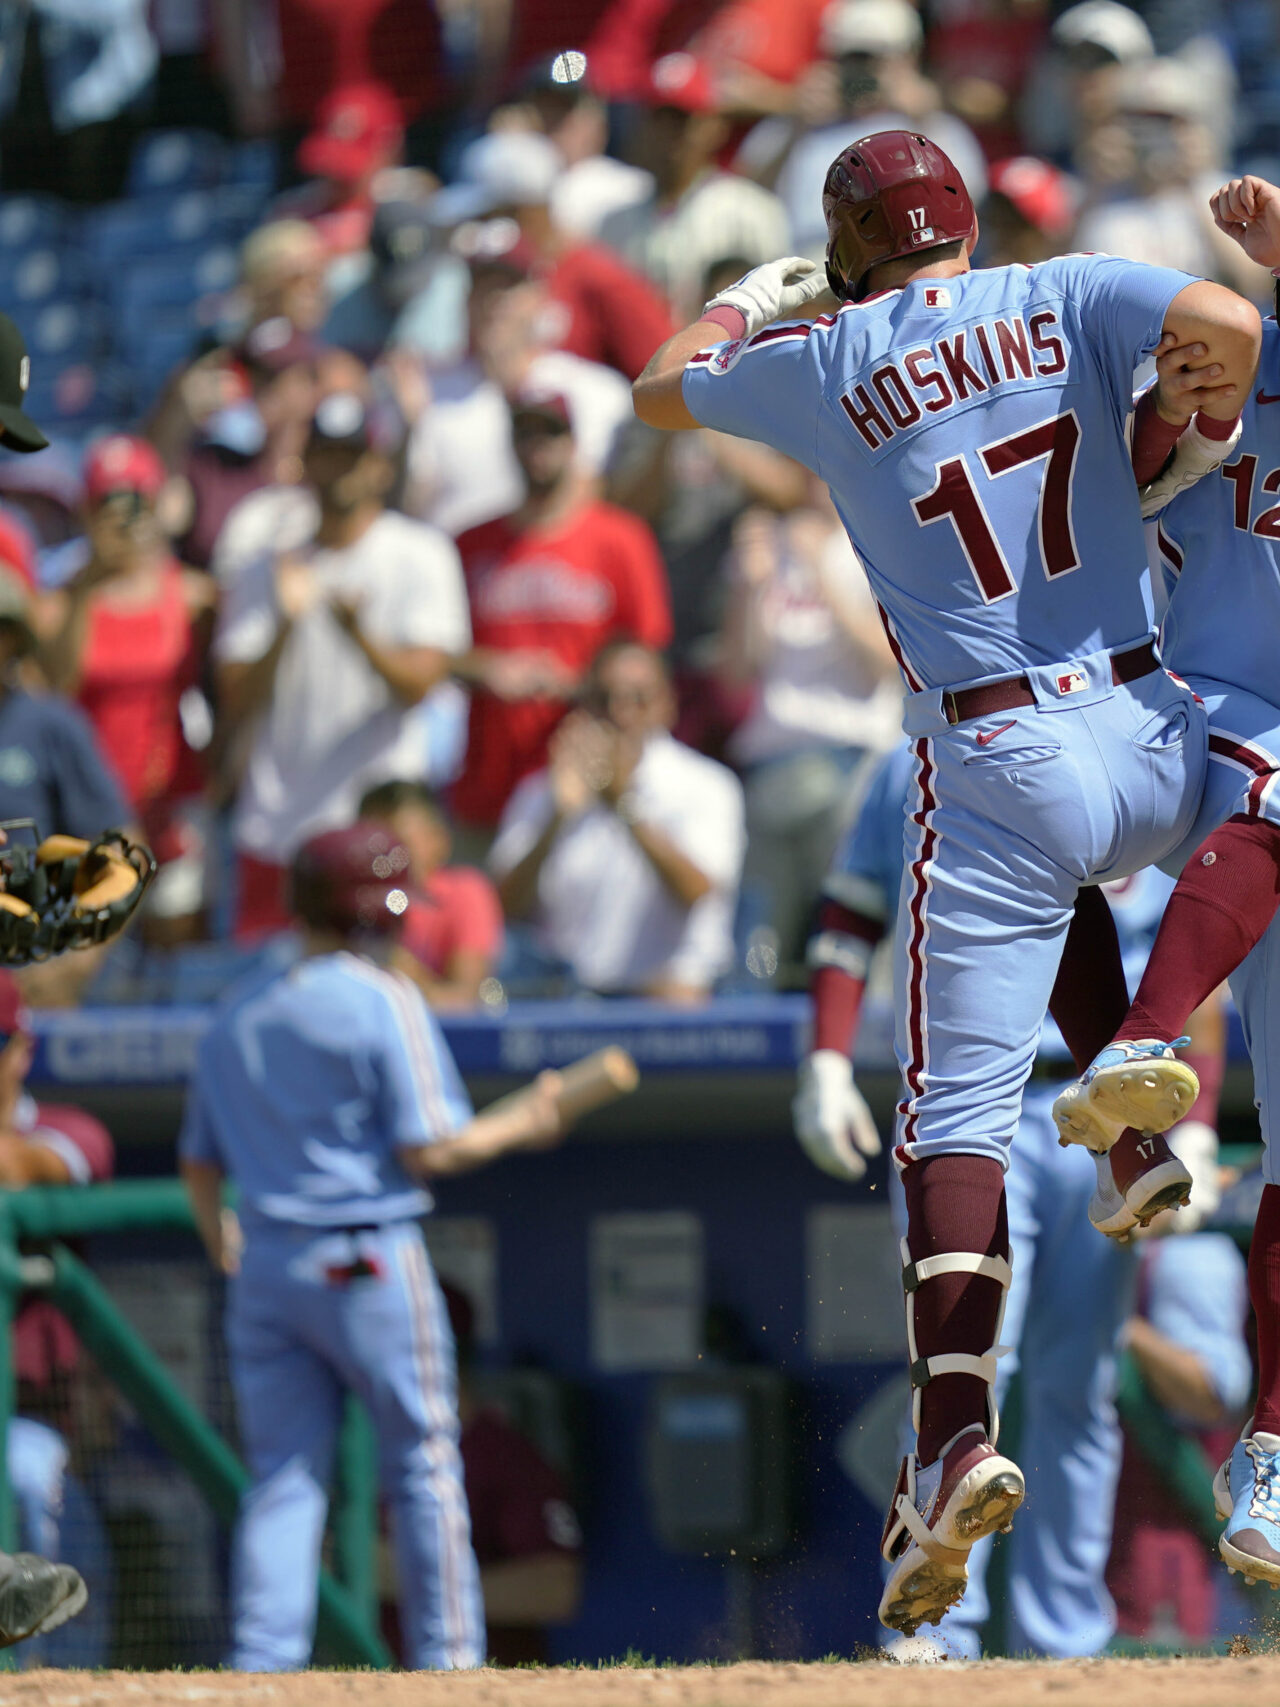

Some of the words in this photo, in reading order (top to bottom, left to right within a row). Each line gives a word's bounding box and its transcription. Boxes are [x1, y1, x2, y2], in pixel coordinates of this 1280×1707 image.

[907, 207, 925, 229] 17
[839, 310, 1069, 452] HOSKINS
[909, 408, 1083, 607] 17
[1136, 1139, 1155, 1160] 17
